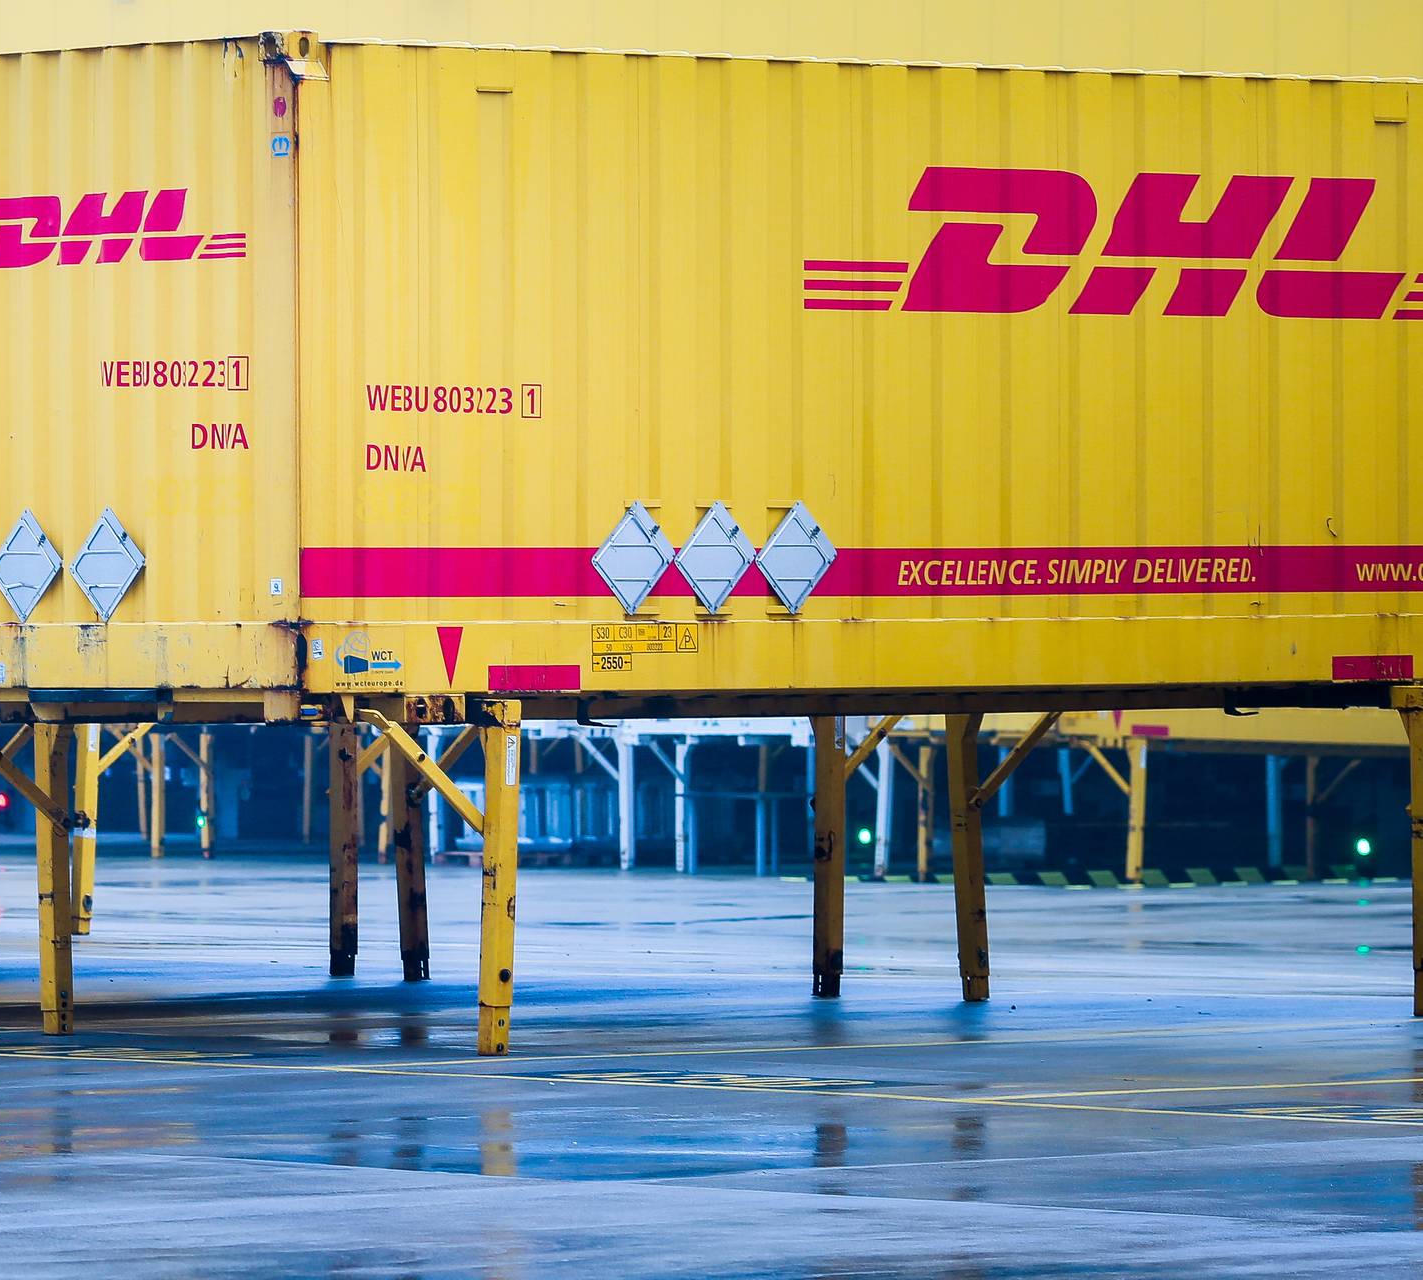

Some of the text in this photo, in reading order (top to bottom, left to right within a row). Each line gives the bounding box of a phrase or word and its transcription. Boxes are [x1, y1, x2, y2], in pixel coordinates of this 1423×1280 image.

[900, 166, 1407, 320] DHL
[366, 385, 428, 412] WEBU
[366, 444, 427, 473] DNVA
[897, 558, 1257, 586] EXCELLENCE. SIMPLY DELIVERED.
[596, 627, 609, 639] S30
[618, 626, 633, 639] C30
[662, 626, 673, 639] 23
[371, 650, 393, 661] WCT
[600, 655, 624, 671] 2550
